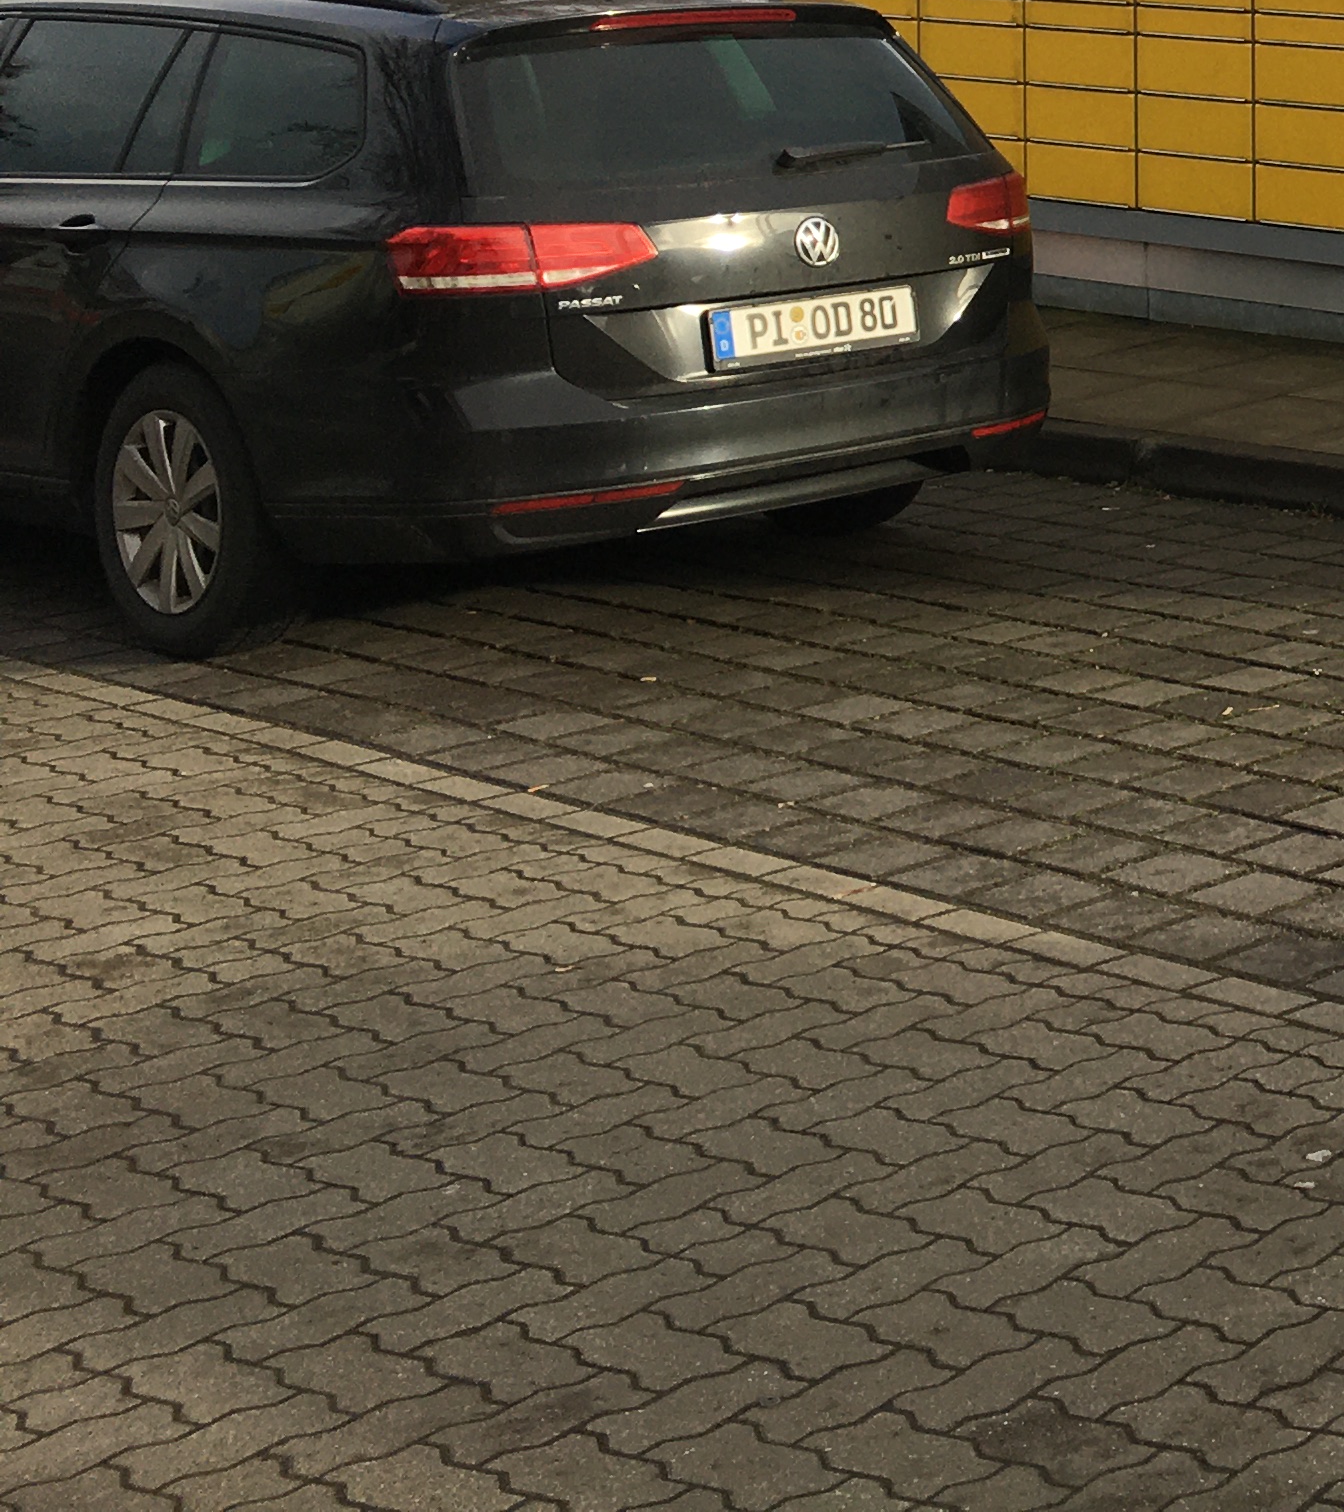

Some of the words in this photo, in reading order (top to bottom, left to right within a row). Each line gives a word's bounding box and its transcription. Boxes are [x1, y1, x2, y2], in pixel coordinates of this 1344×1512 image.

[558, 294, 623, 310] PASSAT
[745, 309, 789, 350] PI
[811, 301, 853, 340] OD
[859, 295, 899, 332] 80
